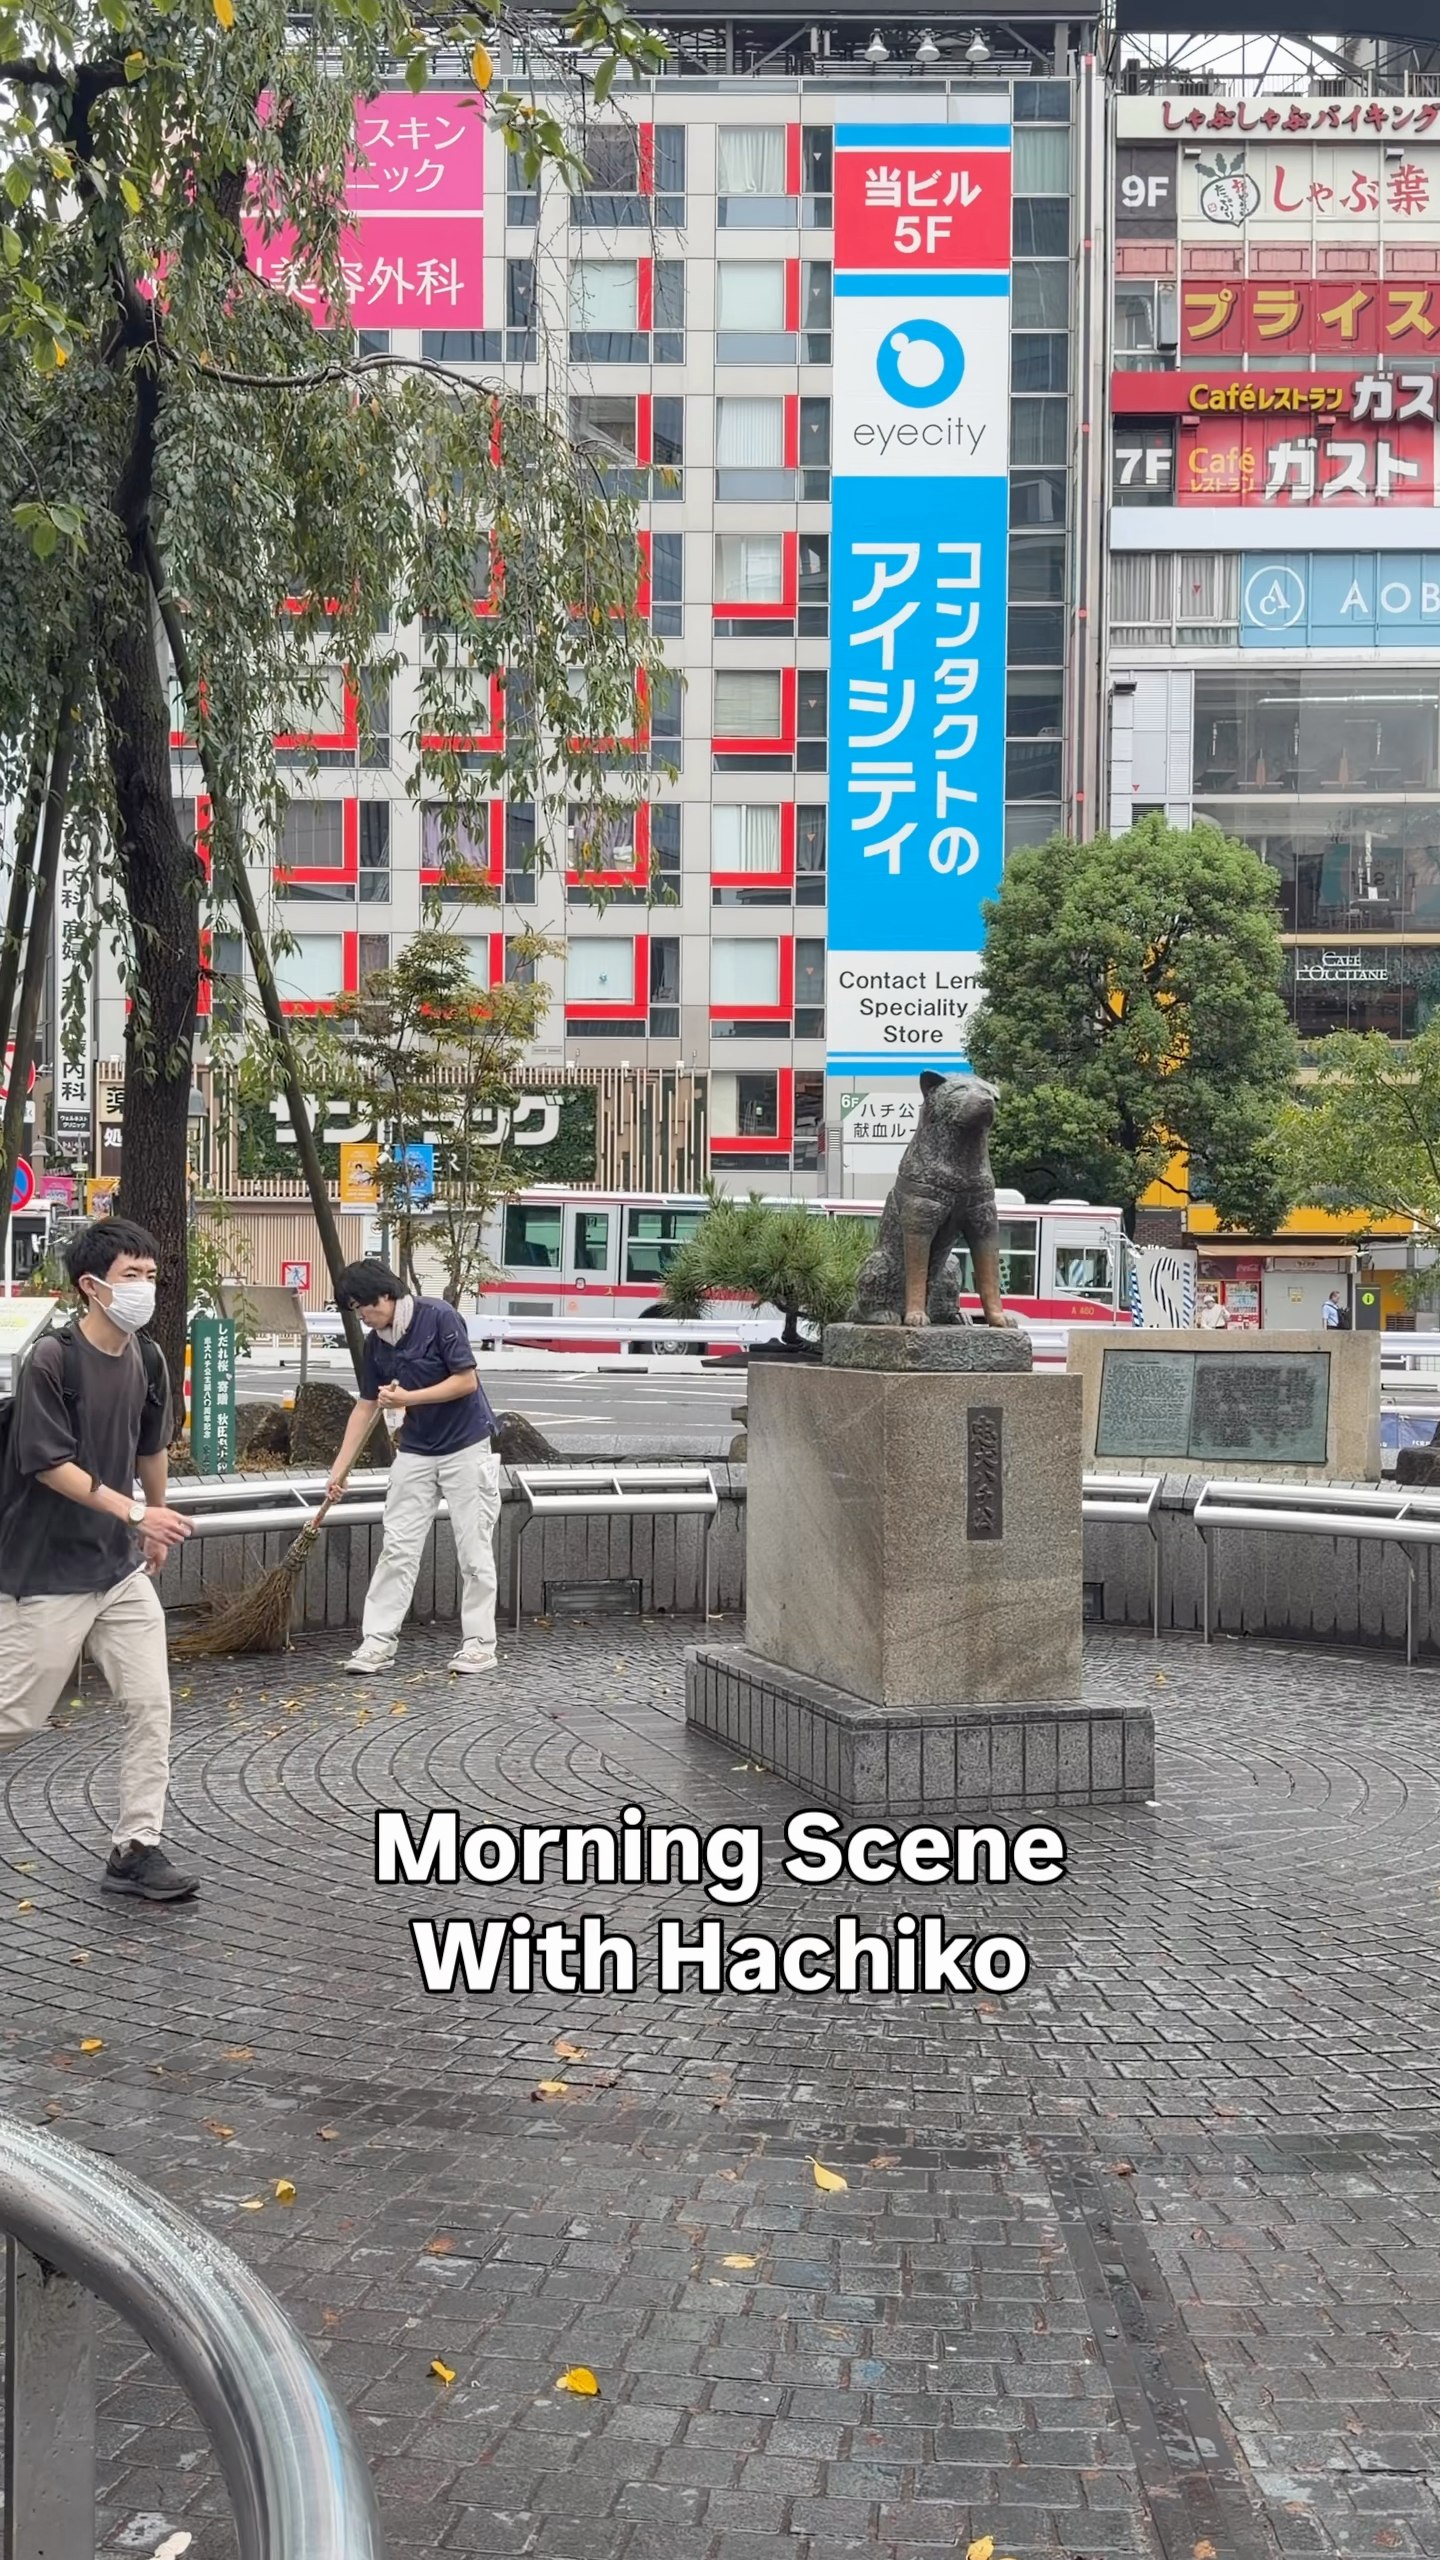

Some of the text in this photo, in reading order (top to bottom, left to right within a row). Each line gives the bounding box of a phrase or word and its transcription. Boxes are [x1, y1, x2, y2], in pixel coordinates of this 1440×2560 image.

[1163, 101, 1440, 132] しゃぶしゃぶバイキング
[865, 166, 983, 207] 当ビル
[1121, 175, 1169, 207] 9F
[1274, 164, 1430, 215] しゃぶ葉
[894, 215, 952, 254] 5F
[1185, 288, 1435, 337] プライス
[853, 416, 986, 456] eyecity
[1115, 449, 1172, 484] 7F
[1188, 447, 1255, 475] Café
[1265, 438, 1418, 499] ガスト
[1190, 476, 1255, 493] レストラン
[848, 543, 921, 875] アイシティ
[928, 543, 981, 876] コンタクトの
[839, 971, 926, 989] Contact
[860, 998, 968, 1018] Speciality
[883, 1025, 943, 1043] Store
[841, 1094, 859, 1108] 6F
